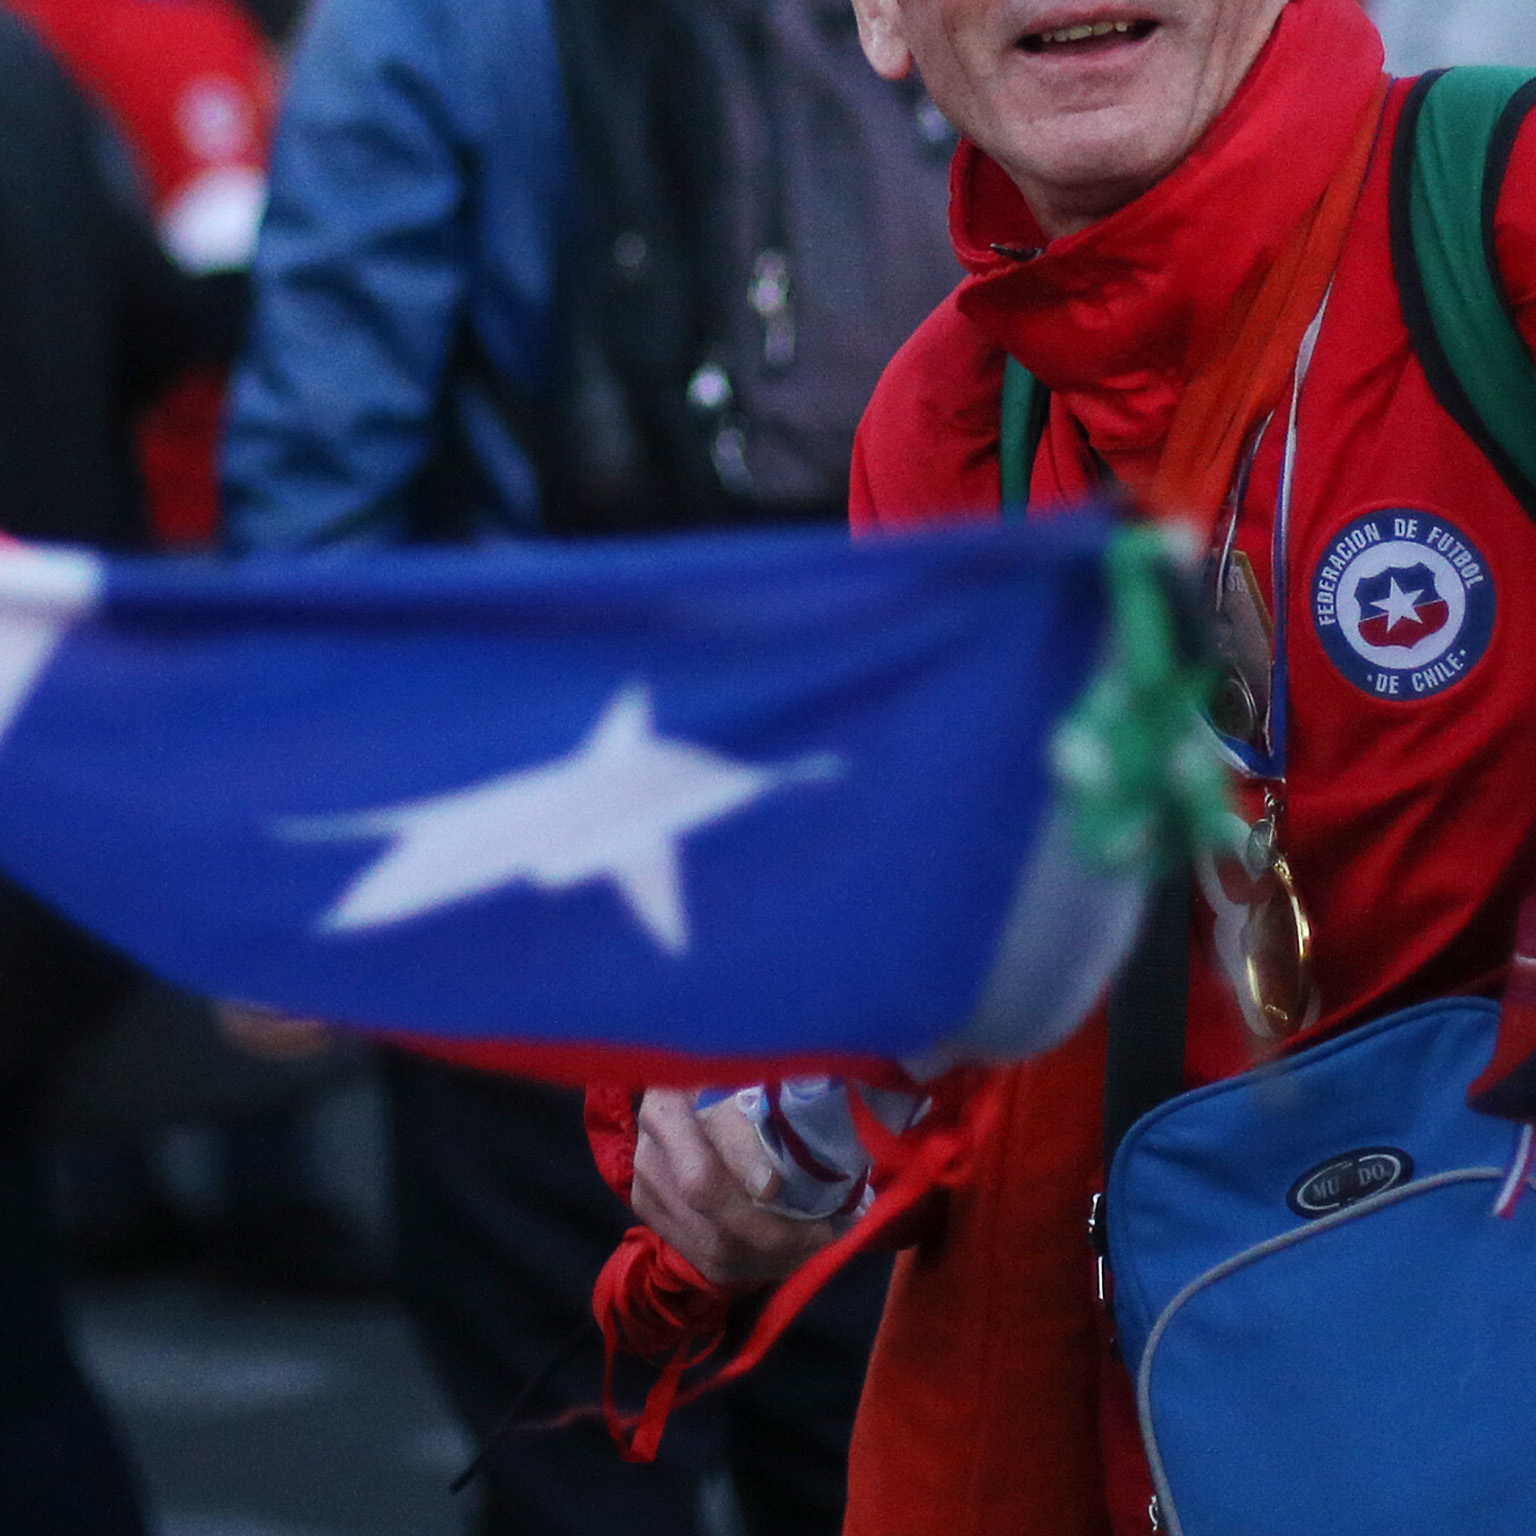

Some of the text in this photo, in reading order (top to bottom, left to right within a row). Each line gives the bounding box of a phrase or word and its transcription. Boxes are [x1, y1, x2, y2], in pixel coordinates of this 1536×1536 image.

[1316, 522, 1381, 626] FEDERACION
[1394, 518, 1418, 539] DE
[1426, 526, 1484, 590] FUTBOL
[1375, 652, 1464, 694] DE CHILE
